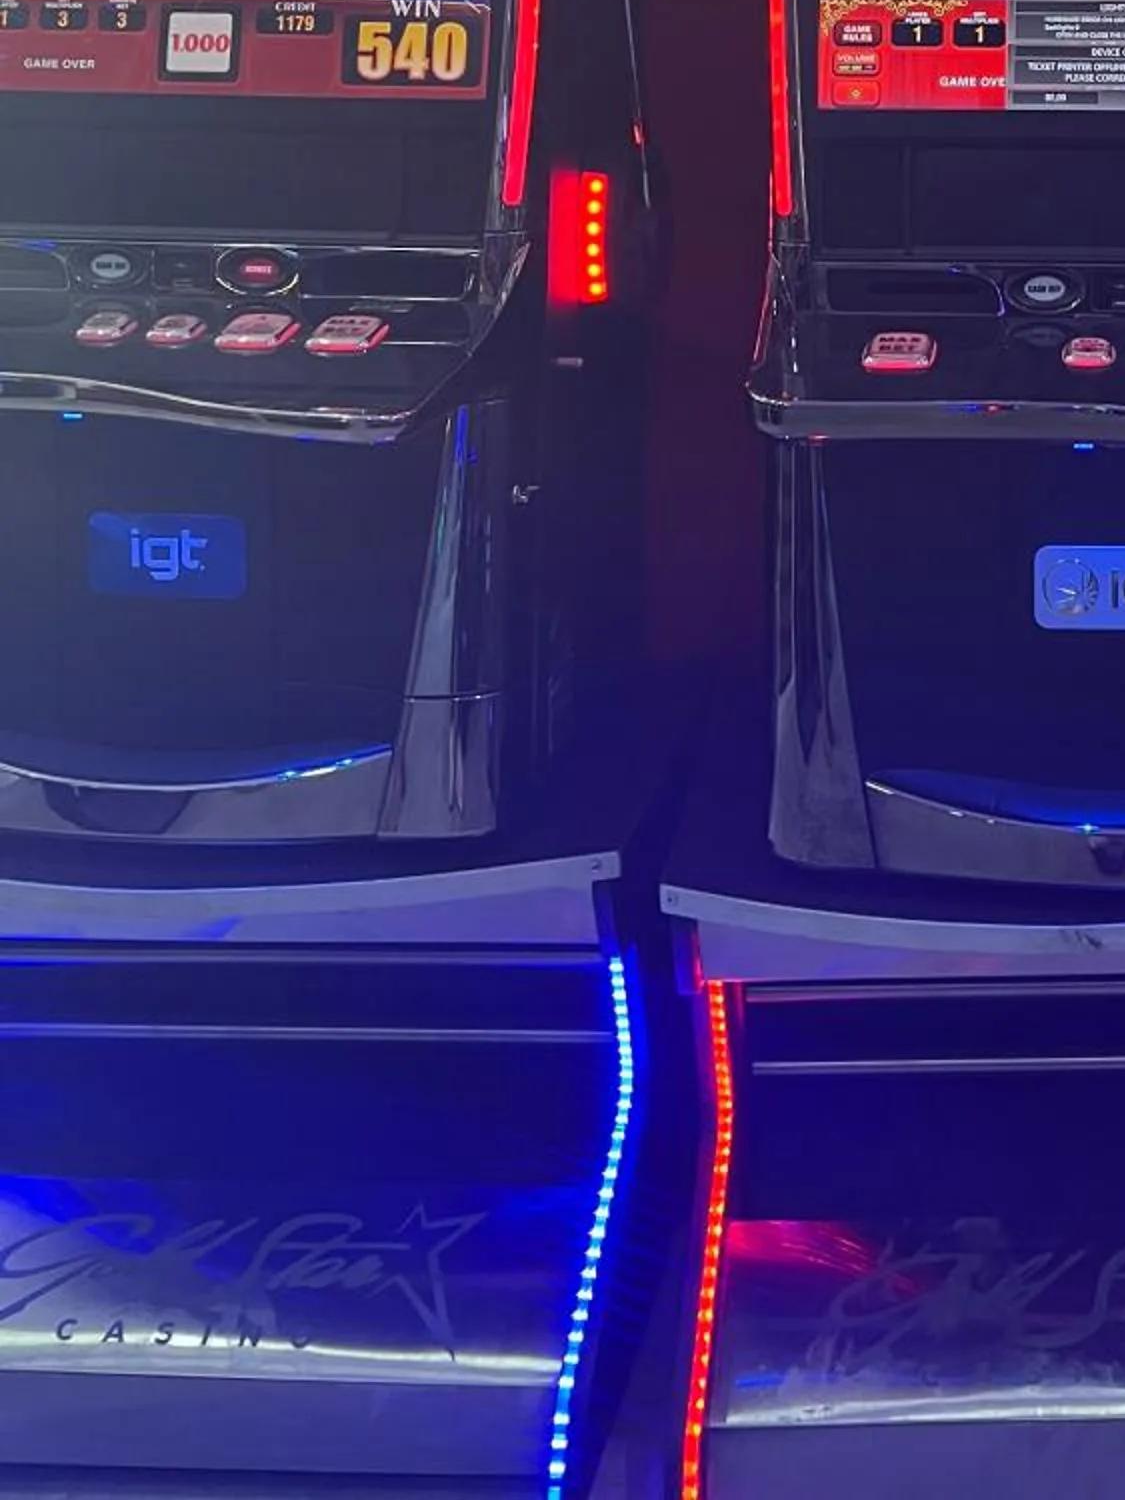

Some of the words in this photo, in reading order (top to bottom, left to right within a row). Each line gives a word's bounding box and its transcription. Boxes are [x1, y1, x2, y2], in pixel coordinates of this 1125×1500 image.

[391, 0, 442, 19] WIN
[57, 10, 69, 28] 3
[116, 11, 128, 29] 3
[276, 15, 316, 32] 1179
[913, 25, 923, 43] 1
[974, 25, 985, 44] 1
[356, 21, 468, 81] 540
[981, 76, 1007, 88] OVE
[129, 528, 208, 582] igt
